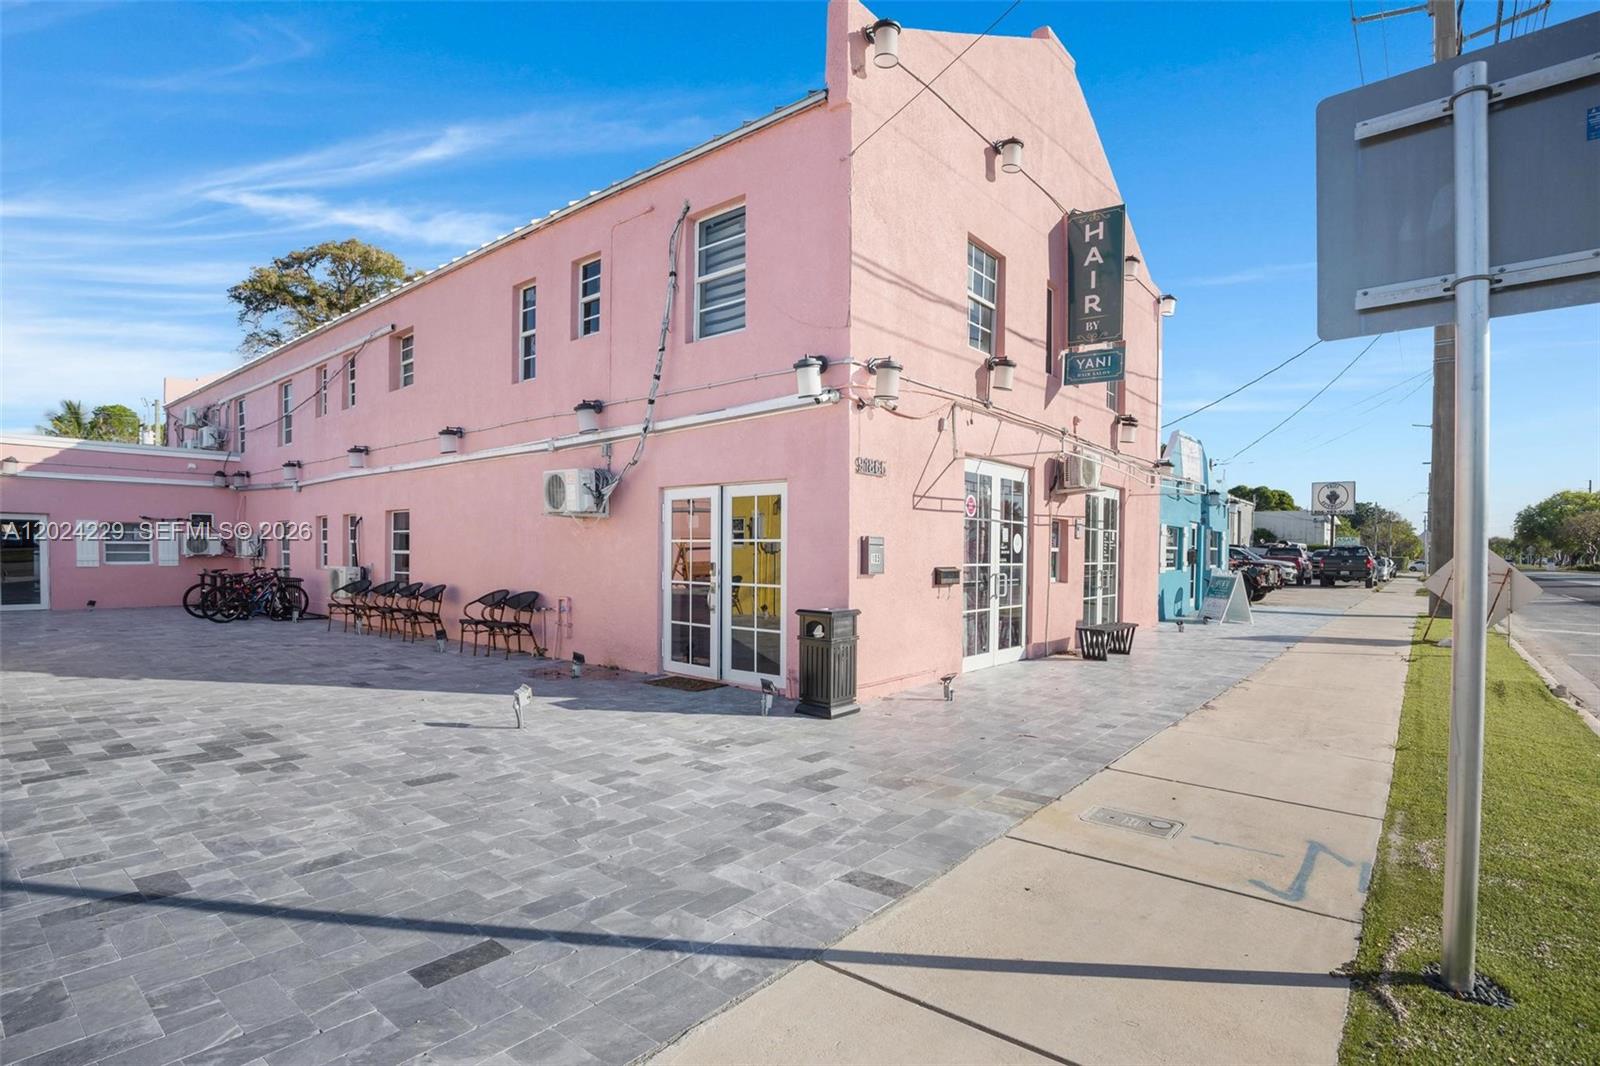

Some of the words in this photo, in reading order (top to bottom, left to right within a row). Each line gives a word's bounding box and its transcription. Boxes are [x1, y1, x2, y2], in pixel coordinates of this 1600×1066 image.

[1083, 221, 1105, 314] HAIR
[1085, 320, 1100, 331] BY
[1076, 355, 1112, 369] YANI
